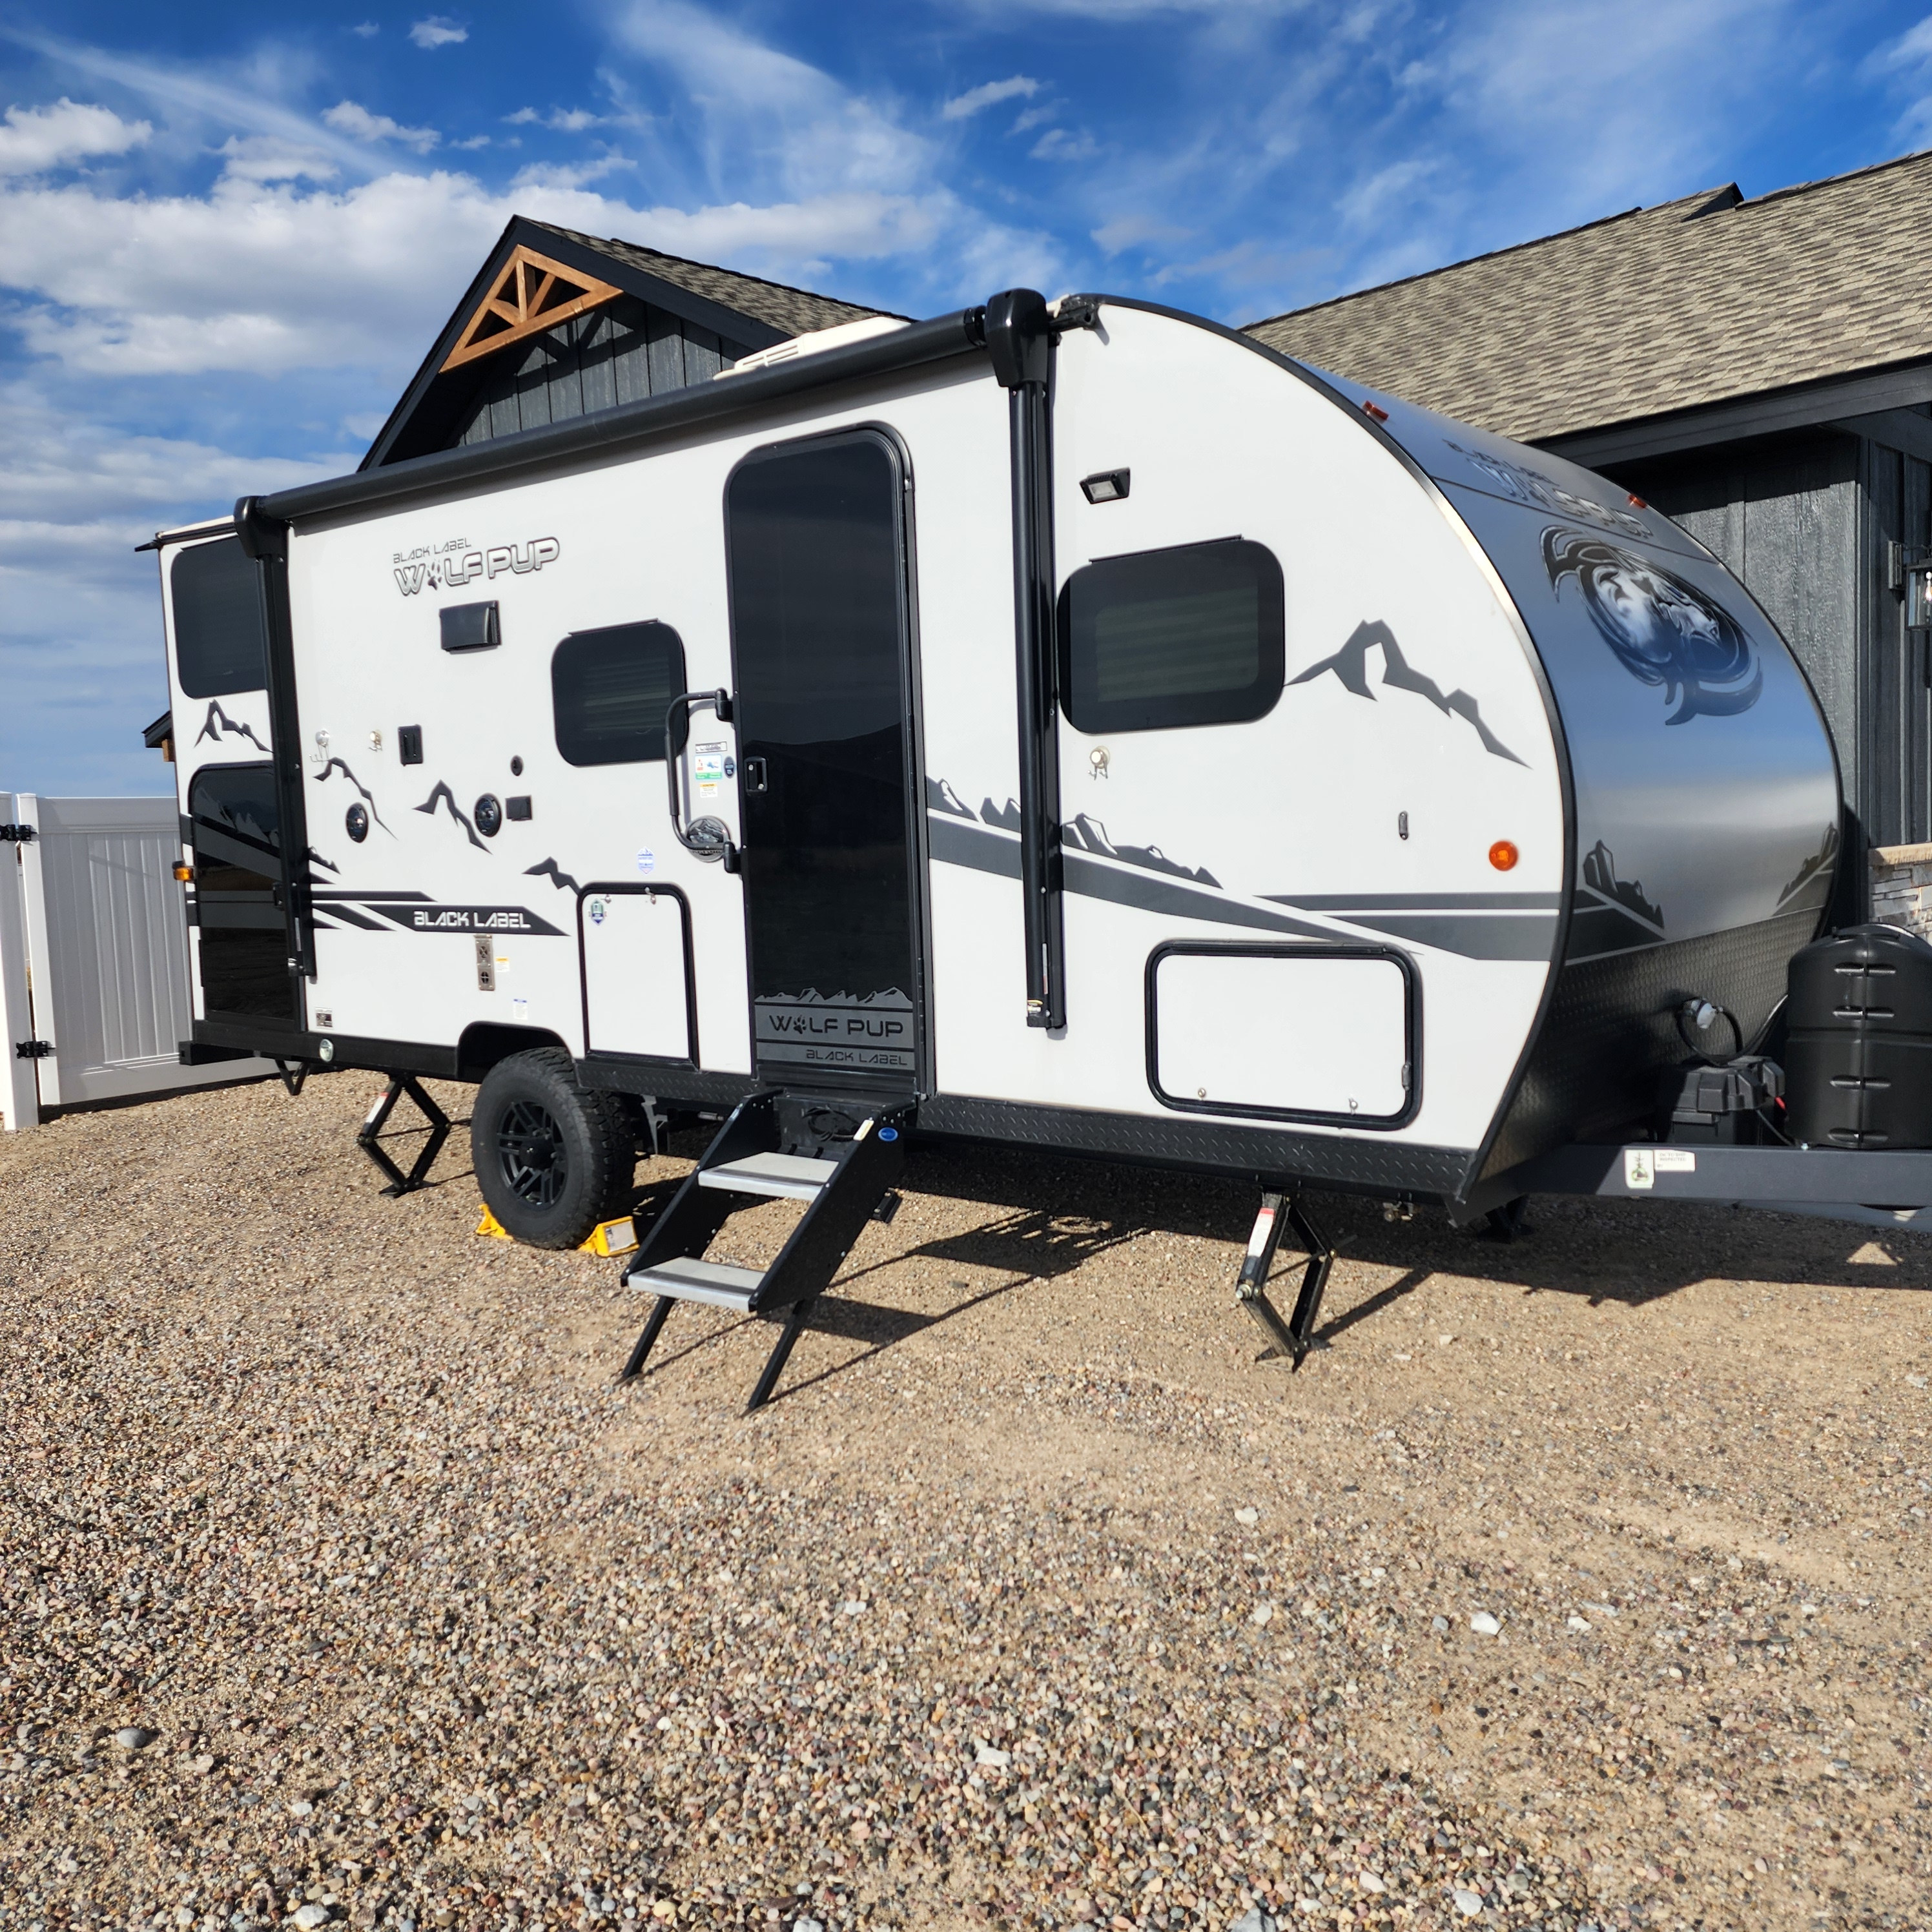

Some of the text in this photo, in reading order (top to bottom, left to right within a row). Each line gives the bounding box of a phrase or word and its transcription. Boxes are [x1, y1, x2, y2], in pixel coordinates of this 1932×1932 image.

[393, 537, 472, 564] BLACK LABEL
[486, 536, 560, 580] PUP
[413, 910, 531, 929] BLACK LABEL
[847, 1018, 903, 1038] PUP
[806, 1049, 908, 1065] BLACK LABEL
